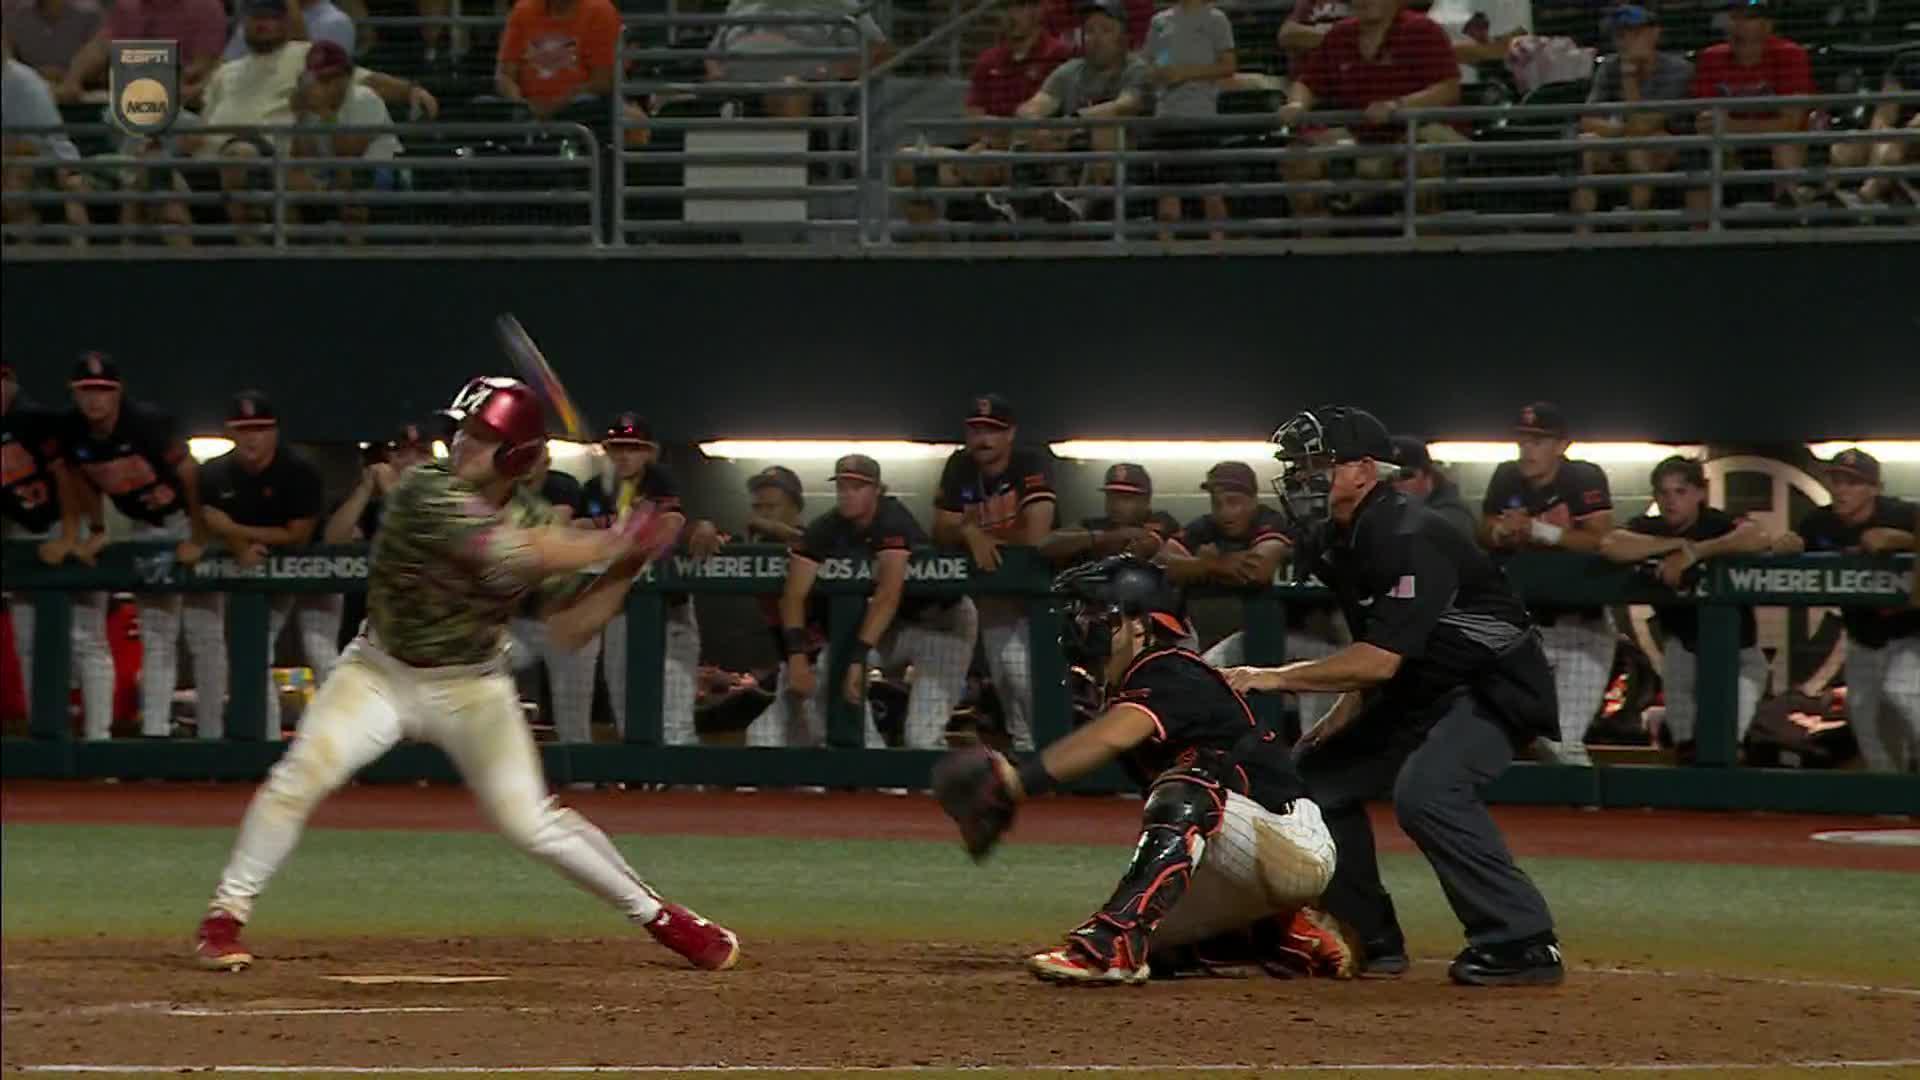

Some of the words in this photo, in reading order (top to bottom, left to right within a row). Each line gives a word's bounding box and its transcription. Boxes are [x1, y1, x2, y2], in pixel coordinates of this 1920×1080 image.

[271, 556, 369, 578] LEGENDS
[674, 556, 751, 578] WHERE
[755, 556, 853, 579] LEDS
[903, 557, 969, 580] MADE
[1728, 568, 1820, 593] WHERE
[1825, 569, 1912, 594] LEGEN
